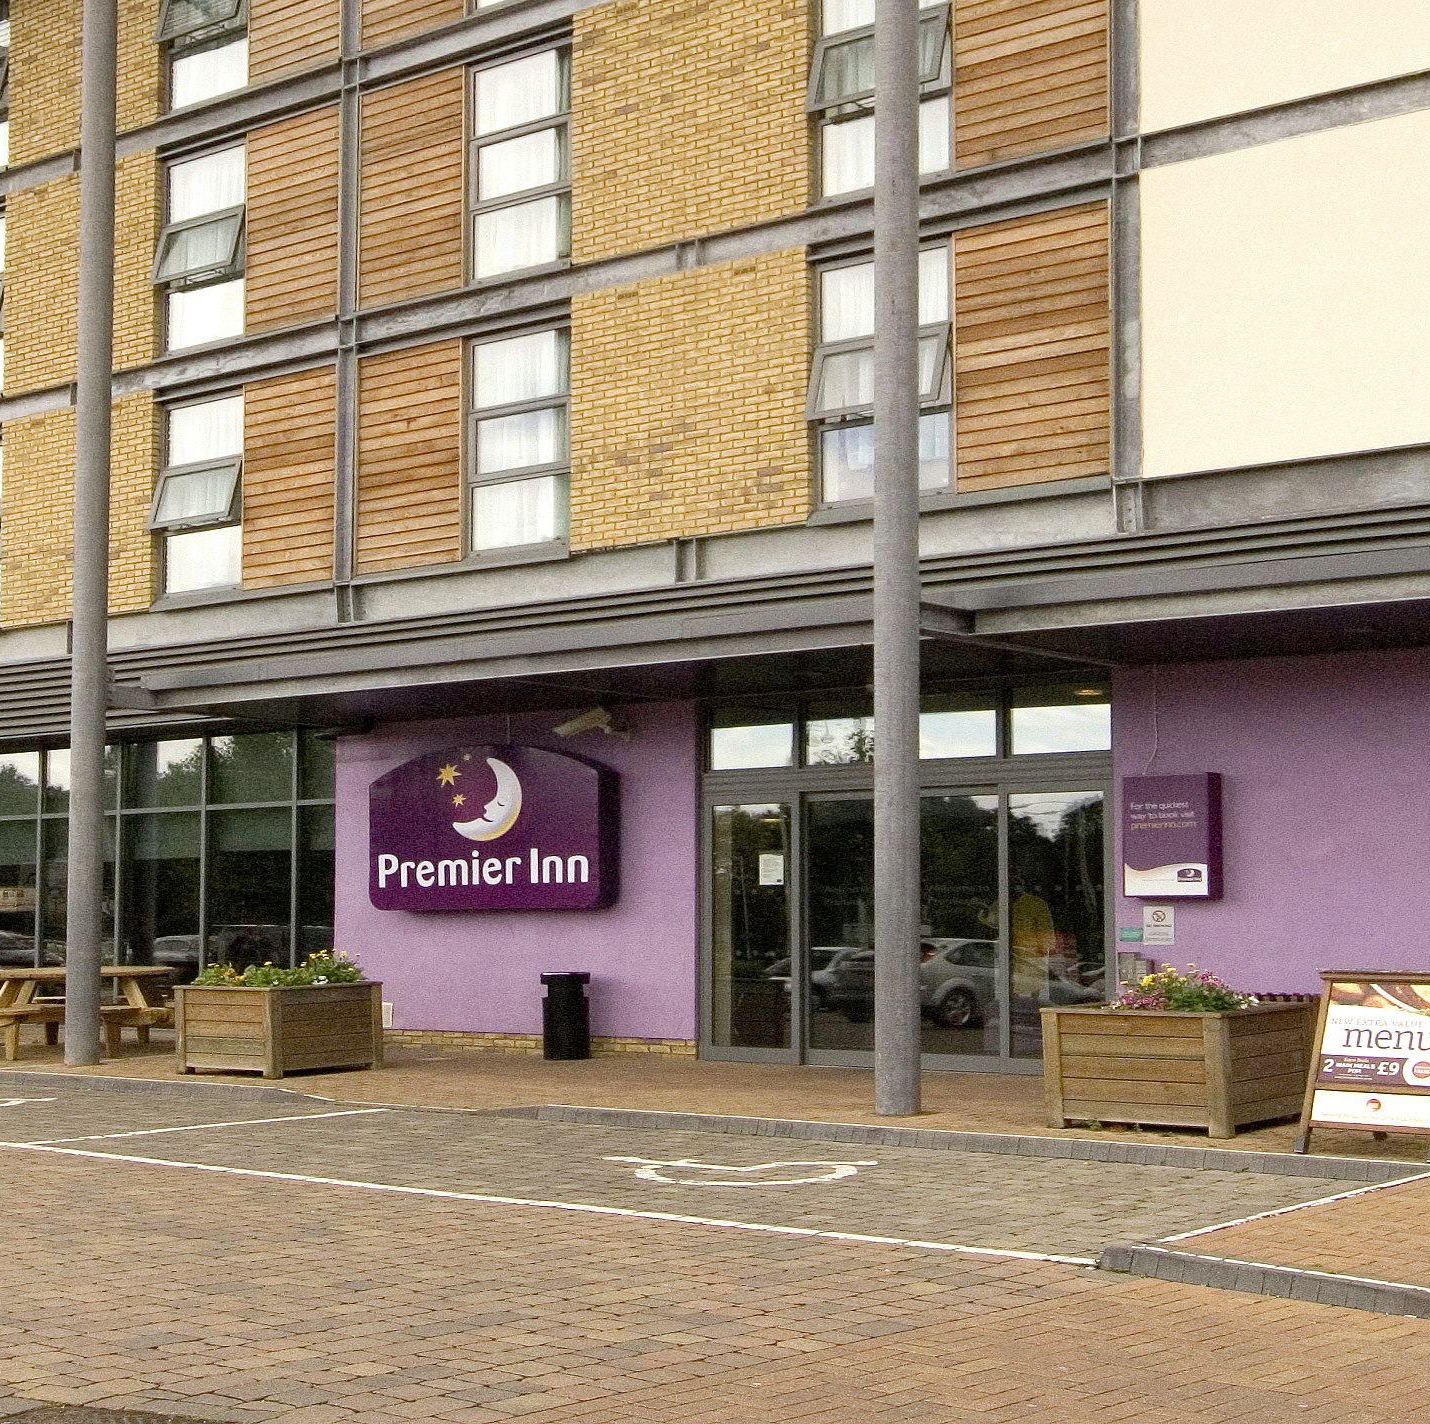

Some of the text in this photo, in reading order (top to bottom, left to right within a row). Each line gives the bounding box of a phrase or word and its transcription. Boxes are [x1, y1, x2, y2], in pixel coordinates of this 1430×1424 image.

[1130, 801, 1143, 810] For
[1145, 801, 1158, 810] the
[378, 848, 589, 888] Premier Inn
[1331, 1017, 1424, 1028] NEW EXTRA VALUE
[1323, 1059, 1335, 1073] 2
[1376, 1061, 1400, 1076] £9
